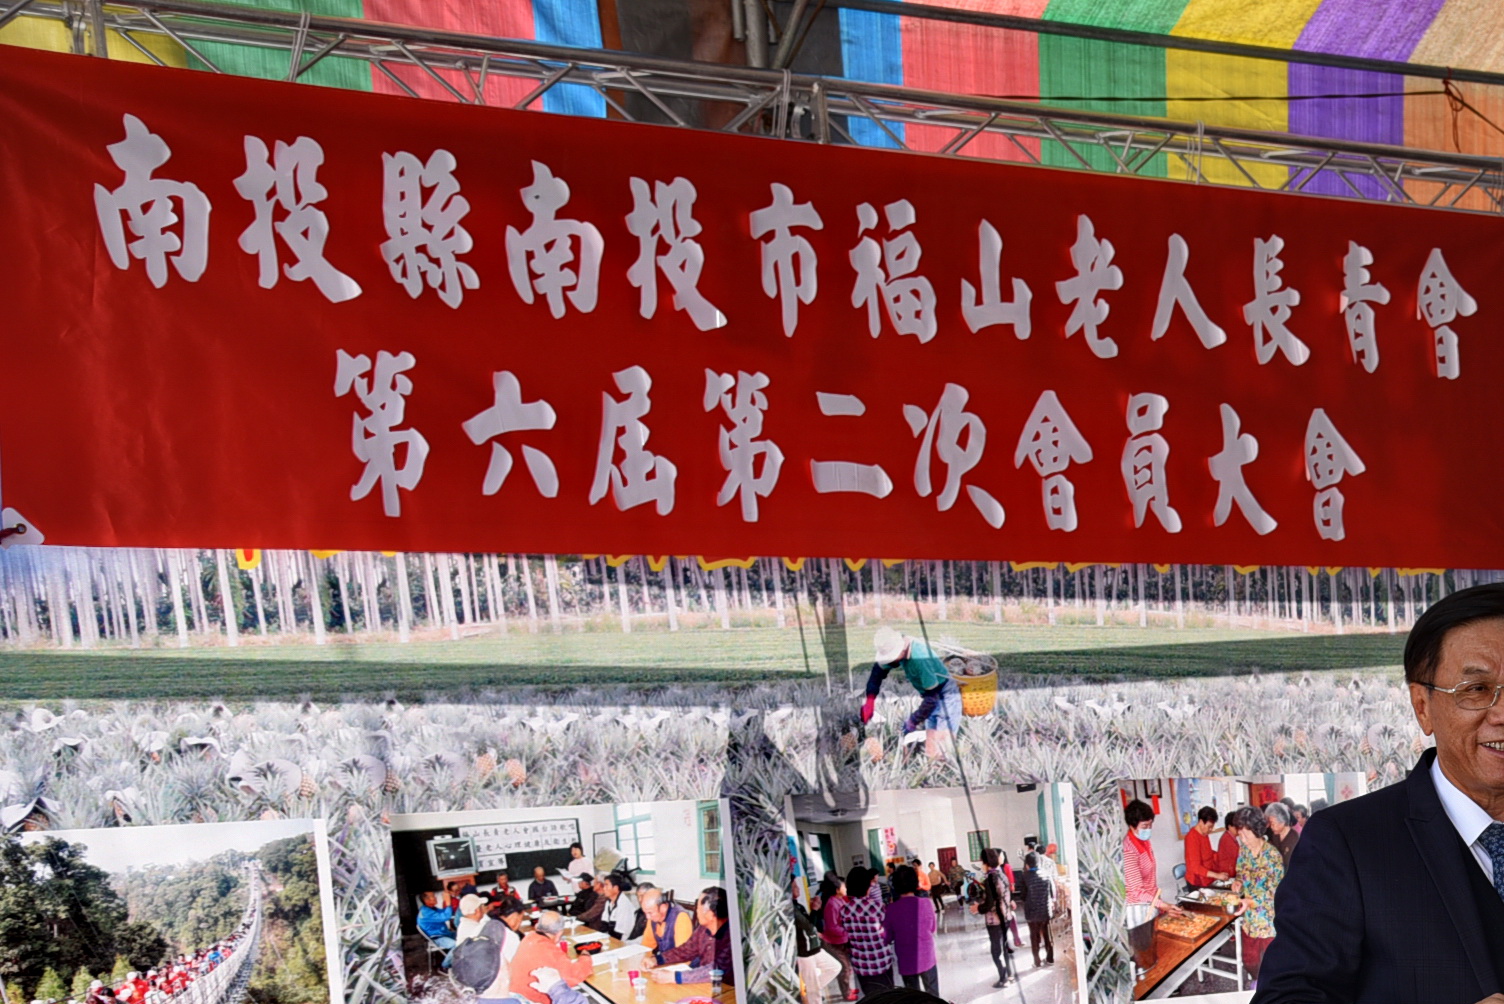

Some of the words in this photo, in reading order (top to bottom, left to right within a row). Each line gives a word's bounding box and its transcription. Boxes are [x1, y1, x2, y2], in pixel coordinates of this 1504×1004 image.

[94, 112, 1478, 380] 南投縣南投市福山老人長青會
[334, 348, 1366, 542] 第六屆第二次會員大會
